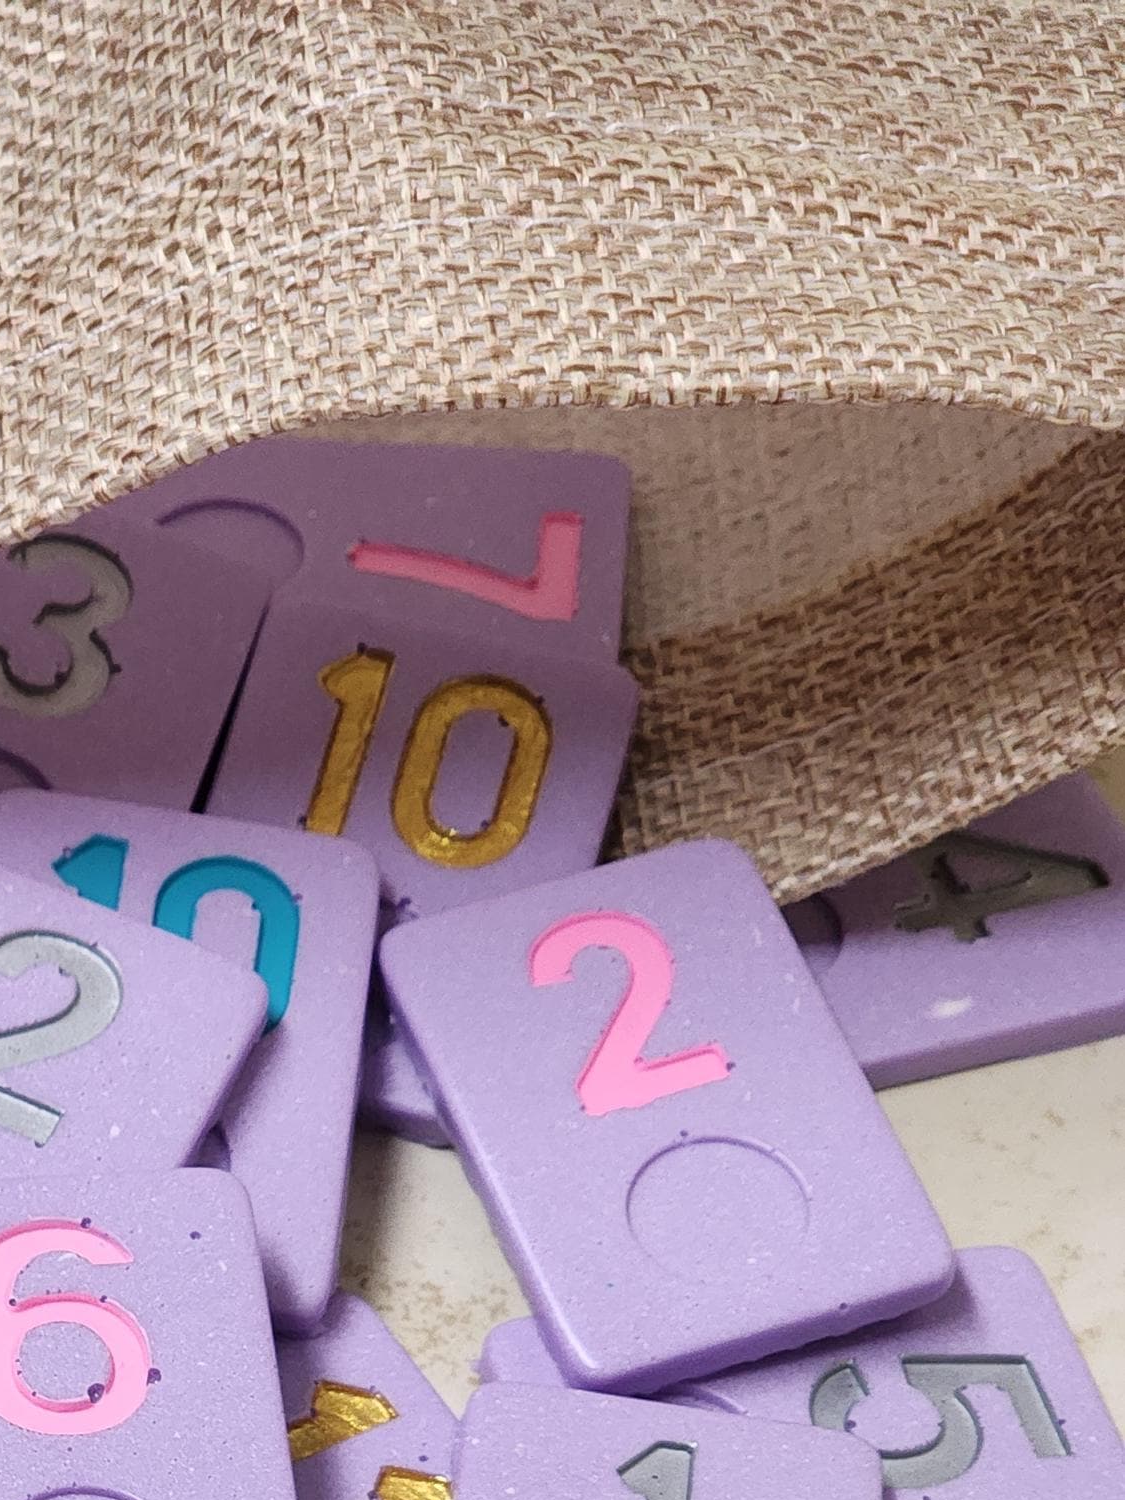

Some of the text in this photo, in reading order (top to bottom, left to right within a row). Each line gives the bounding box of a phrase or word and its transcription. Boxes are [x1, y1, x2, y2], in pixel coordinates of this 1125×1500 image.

[350, 513, 583, 621] 7
[305, 646, 553, 868] 10
[893, 832, 1110, 944] 4
[528, 909, 731, 1116] 2
[810, 1354, 1073, 1489] 5
